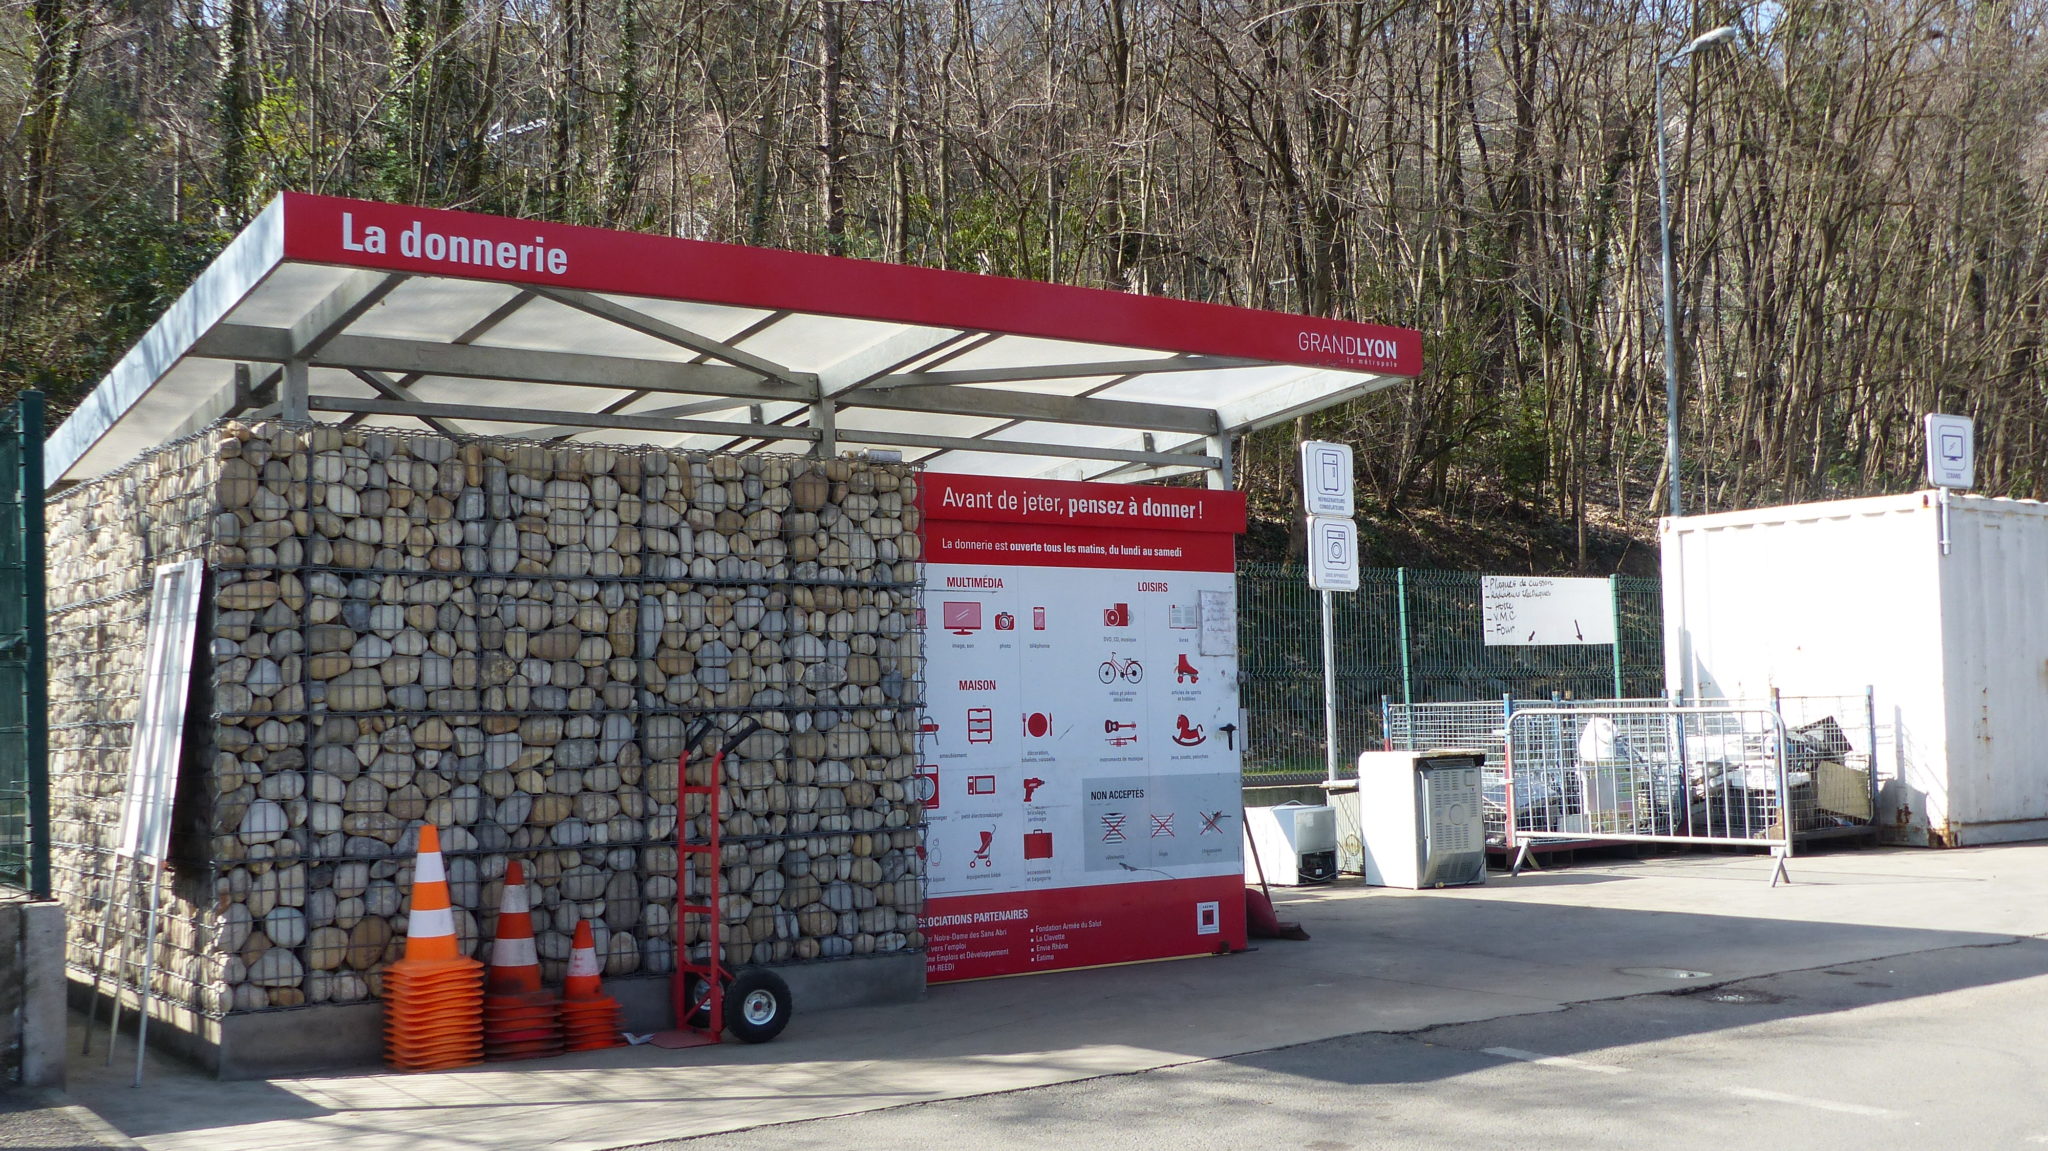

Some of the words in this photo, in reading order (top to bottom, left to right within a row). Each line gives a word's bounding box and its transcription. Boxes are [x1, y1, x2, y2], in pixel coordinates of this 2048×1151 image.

[342, 211, 386, 254] La
[400, 220, 568, 275] donnerie
[1298, 331, 1397, 359] GRANDLYON
[943, 487, 993, 509] Avant
[998, 490, 1018, 510] de
[1022, 491, 1064, 515] jeter,
[1069, 498, 1125, 517] pensez
[1129, 496, 1138, 516] à
[1143, 498, 1196, 519] donner
[1199, 500, 1203, 519] !
[942, 538, 953, 549] La
[955, 539, 992, 551] donnerie
[995, 542, 1008, 551] est
[1010, 542, 1042, 552] ouverte
[1044, 543, 1062, 553] tous
[1063, 543, 1076, 553] les
[1078, 544, 1108, 556] matins,
[1109, 545, 1119, 555] du
[1120, 545, 1141, 556] lundi
[1143, 548, 1153, 556] au
[1154, 547, 1182, 558] samedi
[946, 575, 1004, 589] MULTIMÉDIA
[1137, 582, 1168, 593] LOISIRS
[1520, 579, 1527, 587] de
[1528, 579, 1554, 587] cuisson
[959, 680, 996, 691] MAISON
[1091, 791, 1107, 800] NON
[973, 908, 1029, 923] PARTENAIRES
[1035, 924, 1061, 932] Fondation
[1088, 920, 1102, 928] Salut
[969, 931, 980, 939] des
[980, 930, 994, 938] Sans
[995, 928, 1007, 936] Abri
